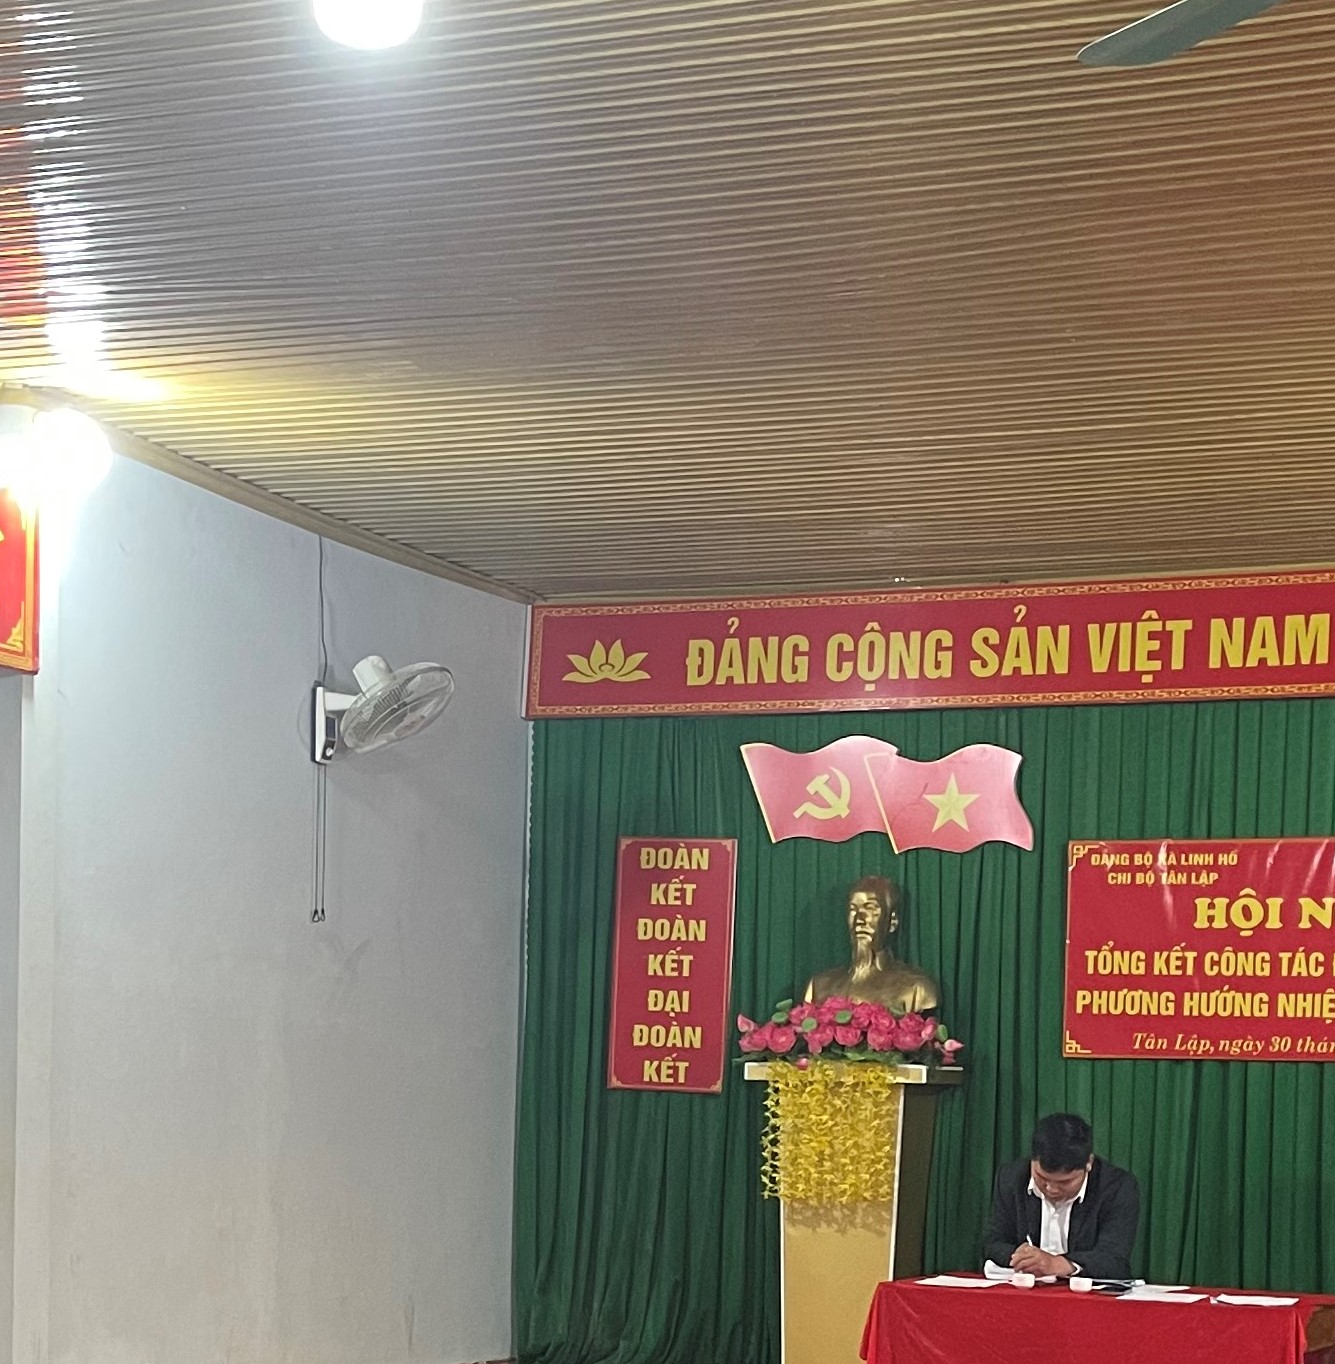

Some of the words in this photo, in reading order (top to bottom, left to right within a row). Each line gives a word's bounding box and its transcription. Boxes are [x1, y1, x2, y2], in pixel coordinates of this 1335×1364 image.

[686, 615, 808, 686] ĐẢNG
[825, 621, 952, 692] CỘNG
[970, 605, 1070, 679] SẢN
[1088, 610, 1193, 683] VIỆT
[1209, 614, 1330, 669] NAM
[640, 843, 709, 870] ĐOÀN
[1181, 853, 1214, 865] LINH
[650, 876, 696, 905] KẾT
[1108, 873, 1131, 885] CHI
[1191, 870, 1218, 887] LẬP
[1194, 887, 1283, 936] HỘI
[637, 915, 706, 941] ĐOÀN
[648, 947, 693, 976] KẾT
[1085, 941, 1146, 975] TỔNG
[1154, 942, 1197, 976] KẾT
[1204, 947, 1270, 977] CÔNG
[1279, 947, 1324, 977] TÁC
[648, 989, 689, 1017] ĐẠI
[1076, 989, 1175, 1015] PHƯƠNG
[1183, 985, 1269, 1017] HƯỚNG
[633, 1022, 701, 1048] ĐOÀN
[1133, 1033, 1167, 1050] Tân
[1175, 1034, 1214, 1055] Lập,
[1219, 1035, 1264, 1056] ngày
[1269, 1036, 1291, 1052] 30
[643, 1053, 689, 1083] KẾT
